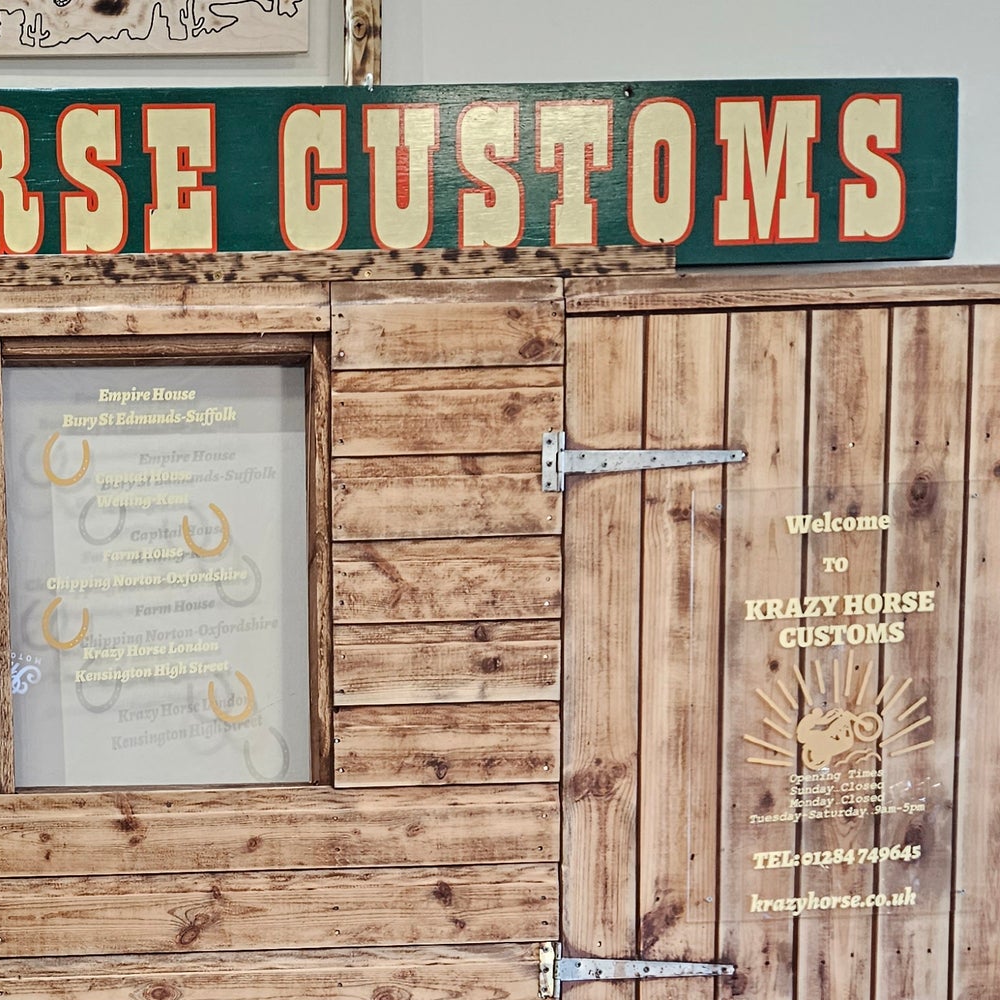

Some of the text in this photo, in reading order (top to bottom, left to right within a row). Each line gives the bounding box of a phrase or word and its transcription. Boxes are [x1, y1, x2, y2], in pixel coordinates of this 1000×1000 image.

[278, 93, 906, 250] CUSTOMS
[98, 387, 196, 405] Empire House
[62, 407, 237, 430] Bury St Edmunds-Suffolk
[785, 511, 892, 534] Welcome
[823, 557, 848, 573] TO
[46, 568, 248, 592] Chipping Norton-Oxfordshire
[744, 590, 936, 621] KRAZY HORSE
[779, 622, 905, 649] CUSTOMS
[83, 640, 219, 661] Krazy Horse London
[75, 660, 229, 683] Kensington High Street
[789, 769, 883, 784] Opening Times
[857, 844, 922, 864] 749645
[749, 886, 917, 916] krazyhorse.co.uk
